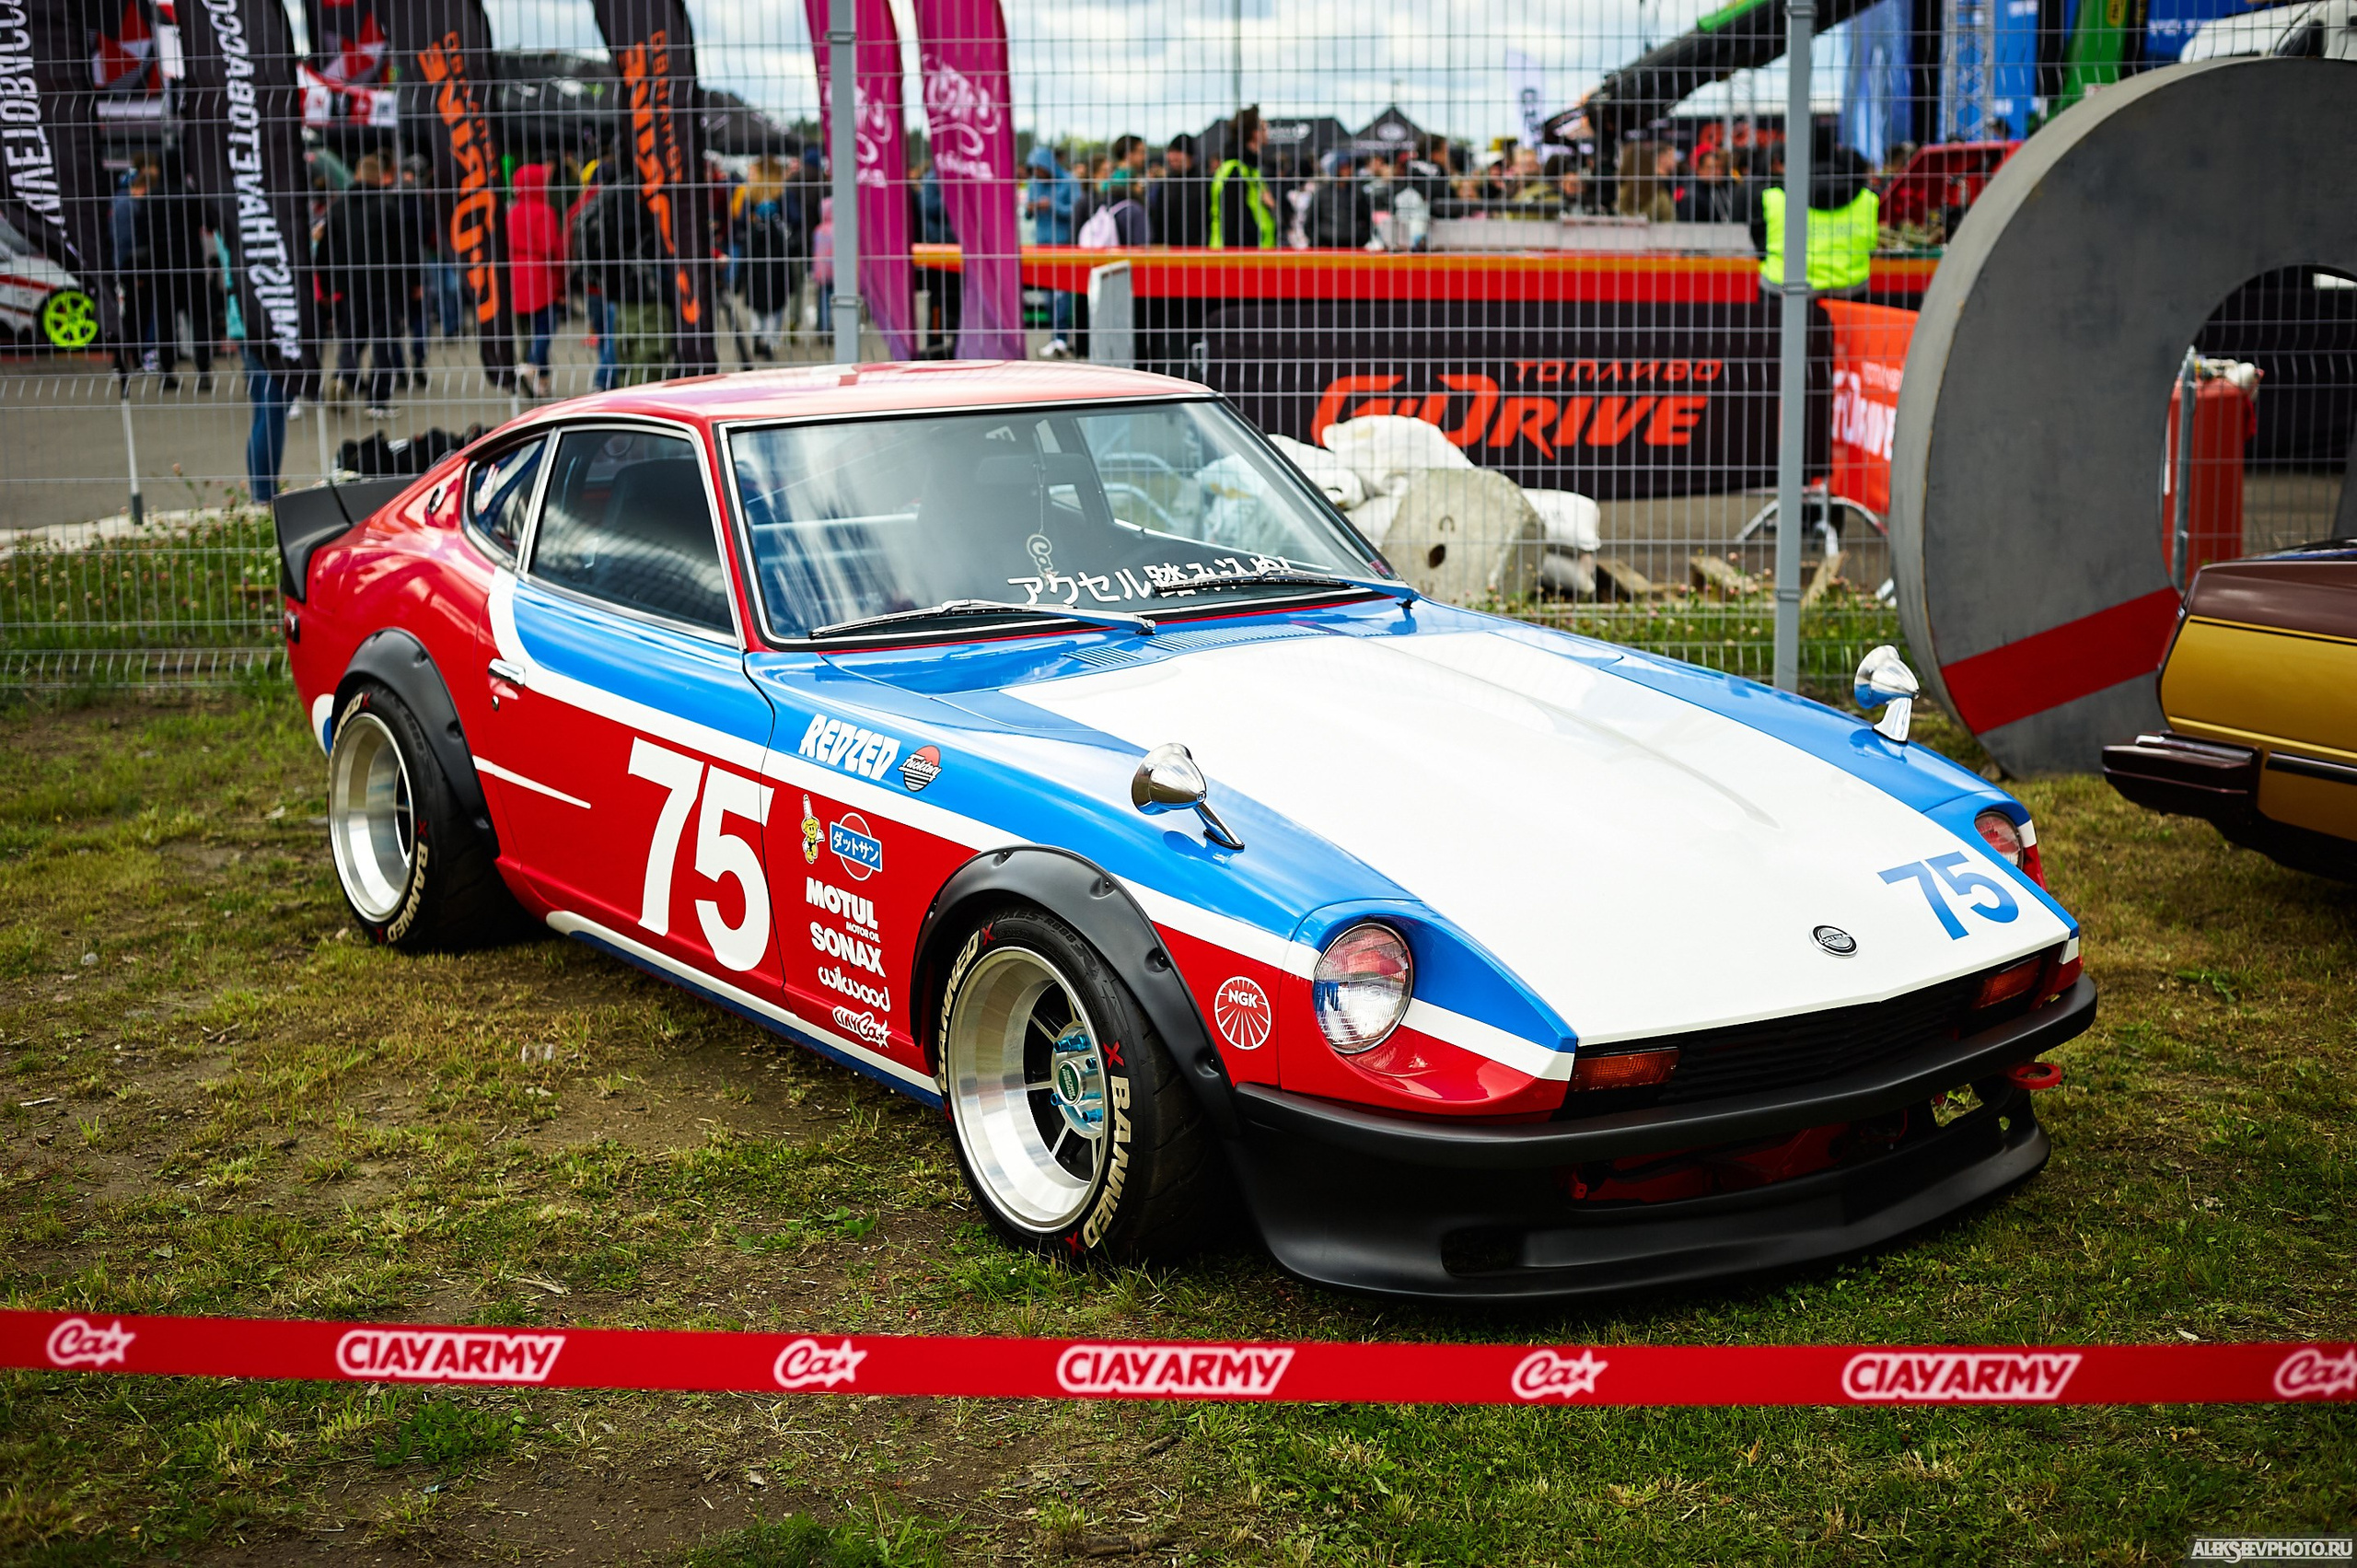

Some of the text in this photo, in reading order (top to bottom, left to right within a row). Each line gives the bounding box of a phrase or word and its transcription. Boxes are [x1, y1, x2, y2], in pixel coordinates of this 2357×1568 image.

[1514, 360, 1723, 381] ТОПЛИВО
[628, 737, 774, 970] 75
[832, 830, 879, 863] ダットサン
[806, 877, 878, 930] MOTUL
[1876, 851, 2019, 940] 75
[810, 922, 887, 977] SONAX
[846, 922, 869, 938] MOTOR
[818, 966, 891, 1013] wilwood
[1227, 988, 1258, 1009] NGK
[1083, 1075, 1131, 1249] BANNED
